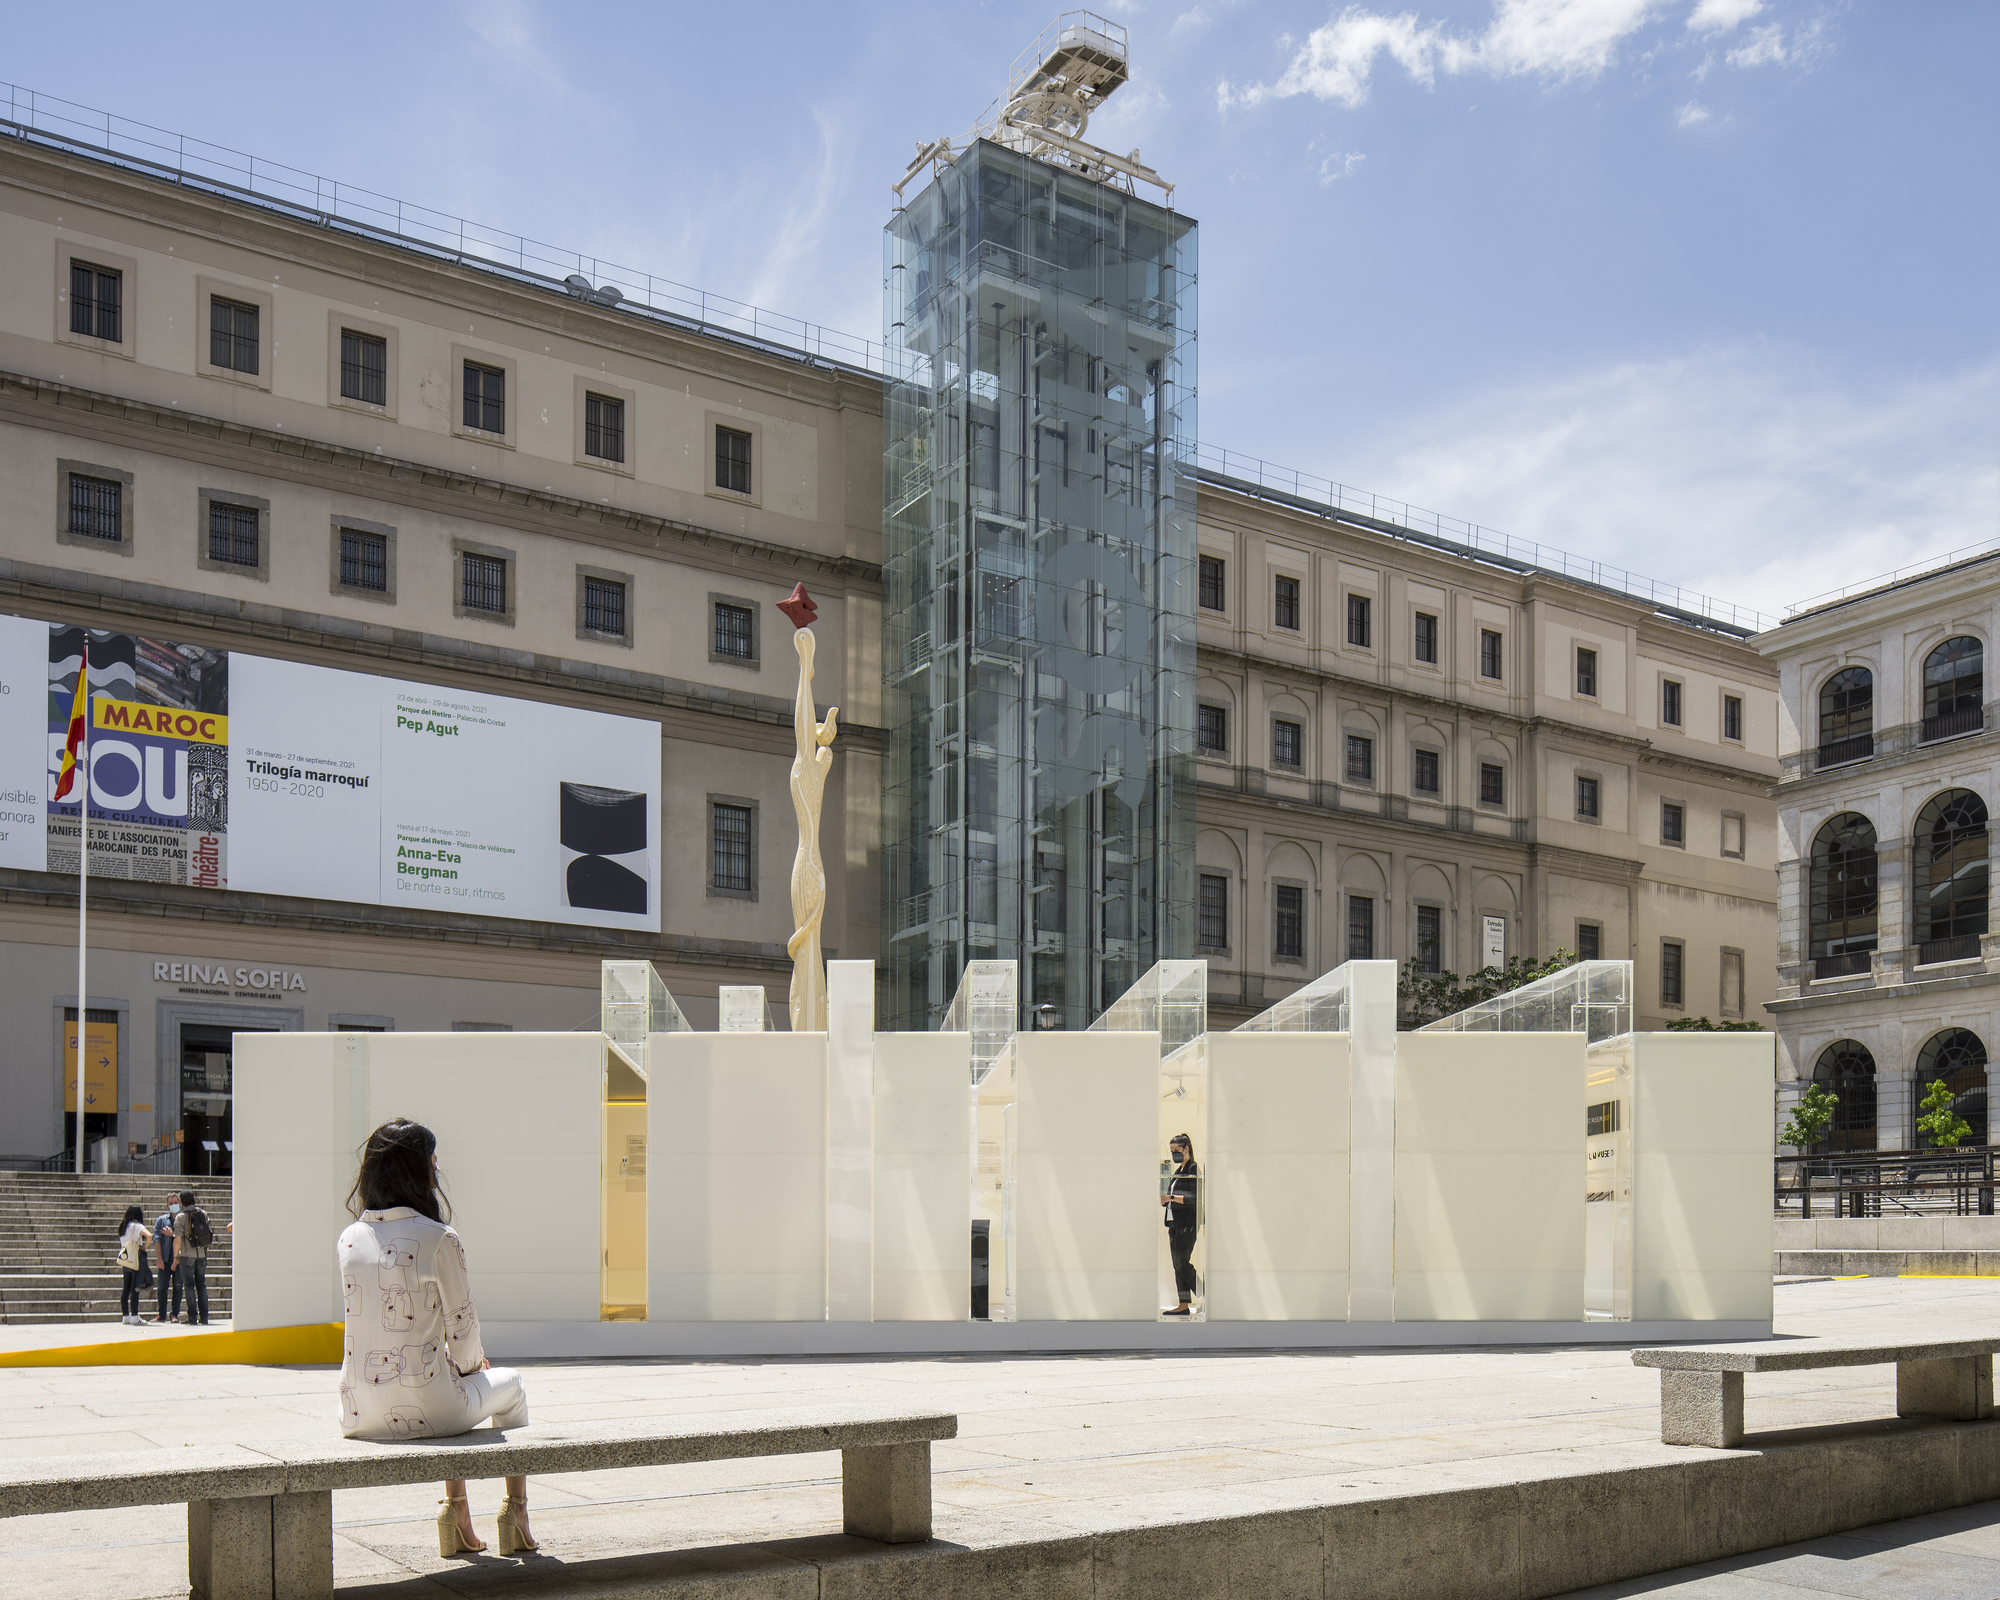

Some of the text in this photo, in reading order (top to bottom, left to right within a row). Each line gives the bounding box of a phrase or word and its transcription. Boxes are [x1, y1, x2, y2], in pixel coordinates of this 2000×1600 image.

[103, 704, 216, 740] MAROC
[397, 704, 420, 714] Parque
[432, 710, 452, 718] Retiro
[456, 714, 478, 723] Palacio
[487, 718, 506, 726] Cristal
[397, 716, 458, 736] Pep Agut
[305, 757, 338, 767] septiembre,
[246, 760, 370, 788] Trilogía marroquí
[246, 777, 278, 792] 1950
[290, 782, 324, 798] 2020
[60, 806, 182, 828] REUE CULTUREL
[397, 823, 414, 831] Hasta
[48, 825, 178, 847] MANIFESE DE L'ASSOCIATION
[397, 834, 420, 842] Parque
[432, 838, 452, 846] Retiro
[456, 841, 478, 850] Palacio
[487, 844, 516, 854] Velázquez
[142, 845, 158, 857] DES
[397, 845, 461, 864] Anna-Eva
[398, 862, 458, 880] Bergman
[397, 878, 506, 900] De norte a sur, ritmos
[154, 961, 306, 992] REINA SOFIA
